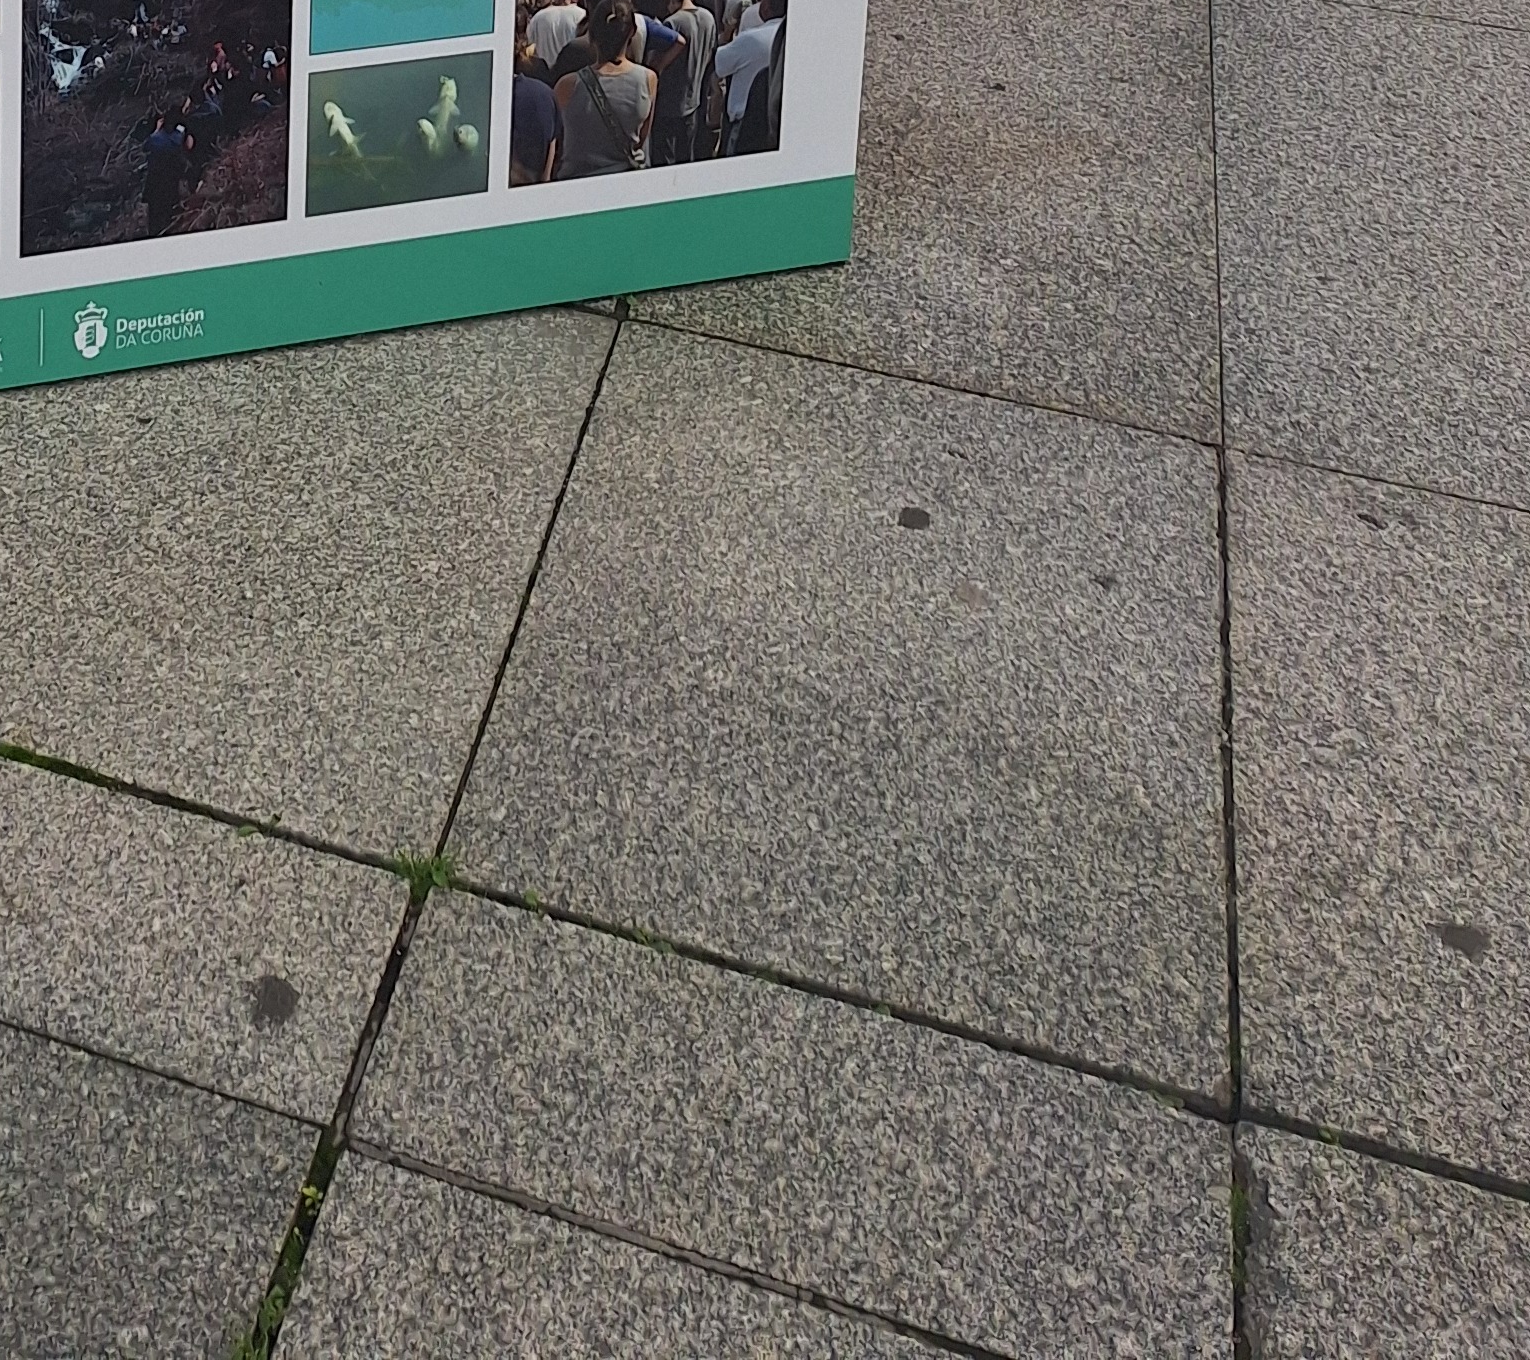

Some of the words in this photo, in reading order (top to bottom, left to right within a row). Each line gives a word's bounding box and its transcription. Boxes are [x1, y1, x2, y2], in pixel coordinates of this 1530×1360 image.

[116, 307, 204, 333] Deputación
[115, 333, 137, 349] DA
[141, 322, 204, 345] CORUÑA
